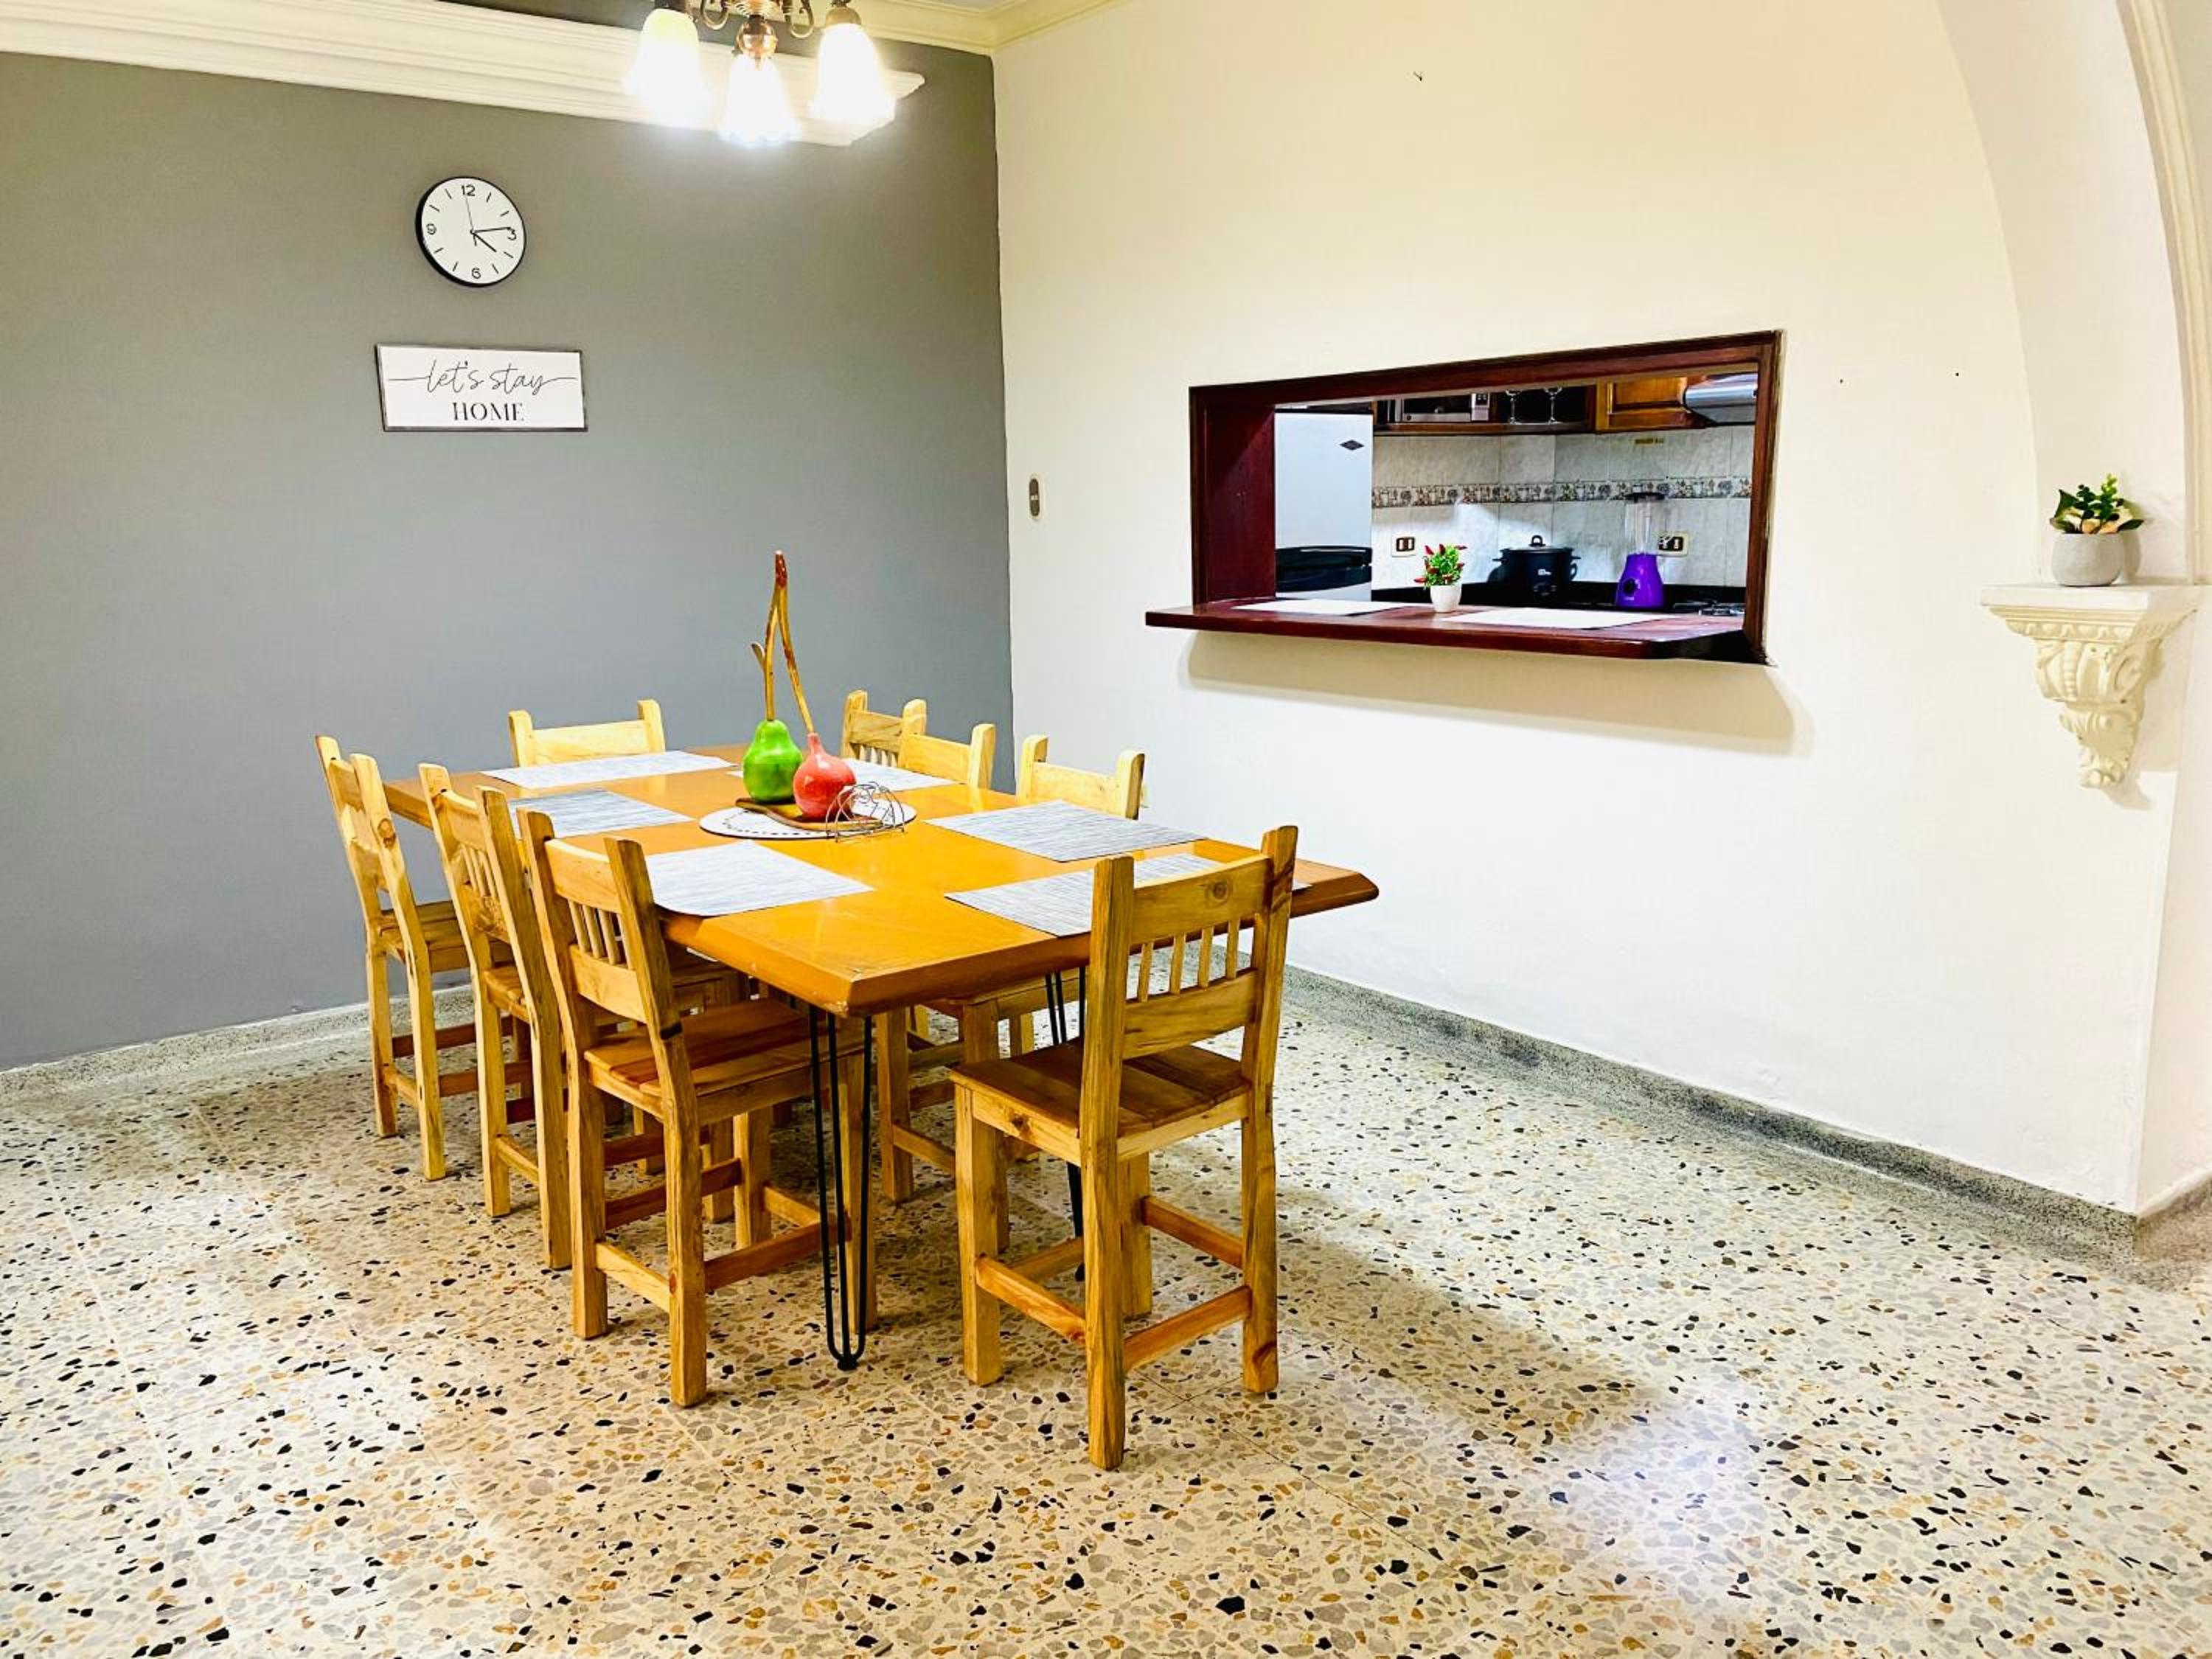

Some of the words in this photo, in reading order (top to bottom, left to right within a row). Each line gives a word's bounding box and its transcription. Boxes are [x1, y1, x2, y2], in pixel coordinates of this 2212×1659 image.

[461, 184, 476, 197] 12
[425, 223, 437, 235] 9
[507, 228, 518, 241] 3
[471, 267, 481, 279] 6
[422, 359, 484, 394] let's
[490, 362, 550, 396] stay
[452, 402, 524, 422] HOME
